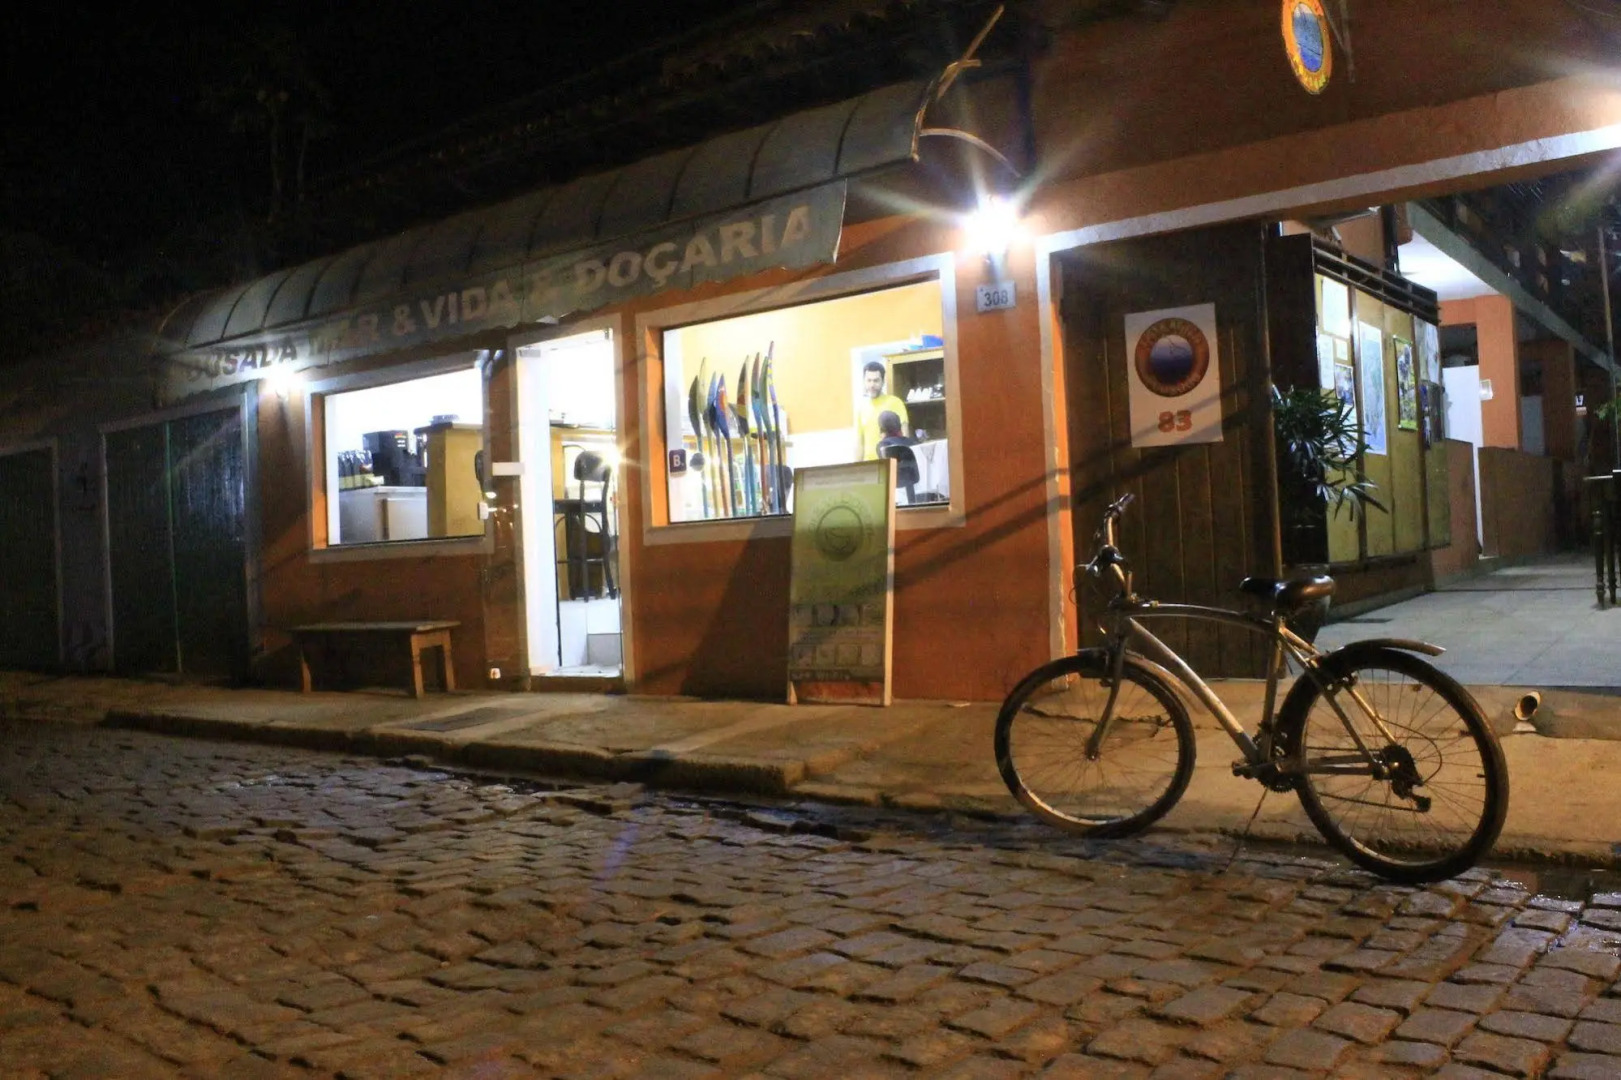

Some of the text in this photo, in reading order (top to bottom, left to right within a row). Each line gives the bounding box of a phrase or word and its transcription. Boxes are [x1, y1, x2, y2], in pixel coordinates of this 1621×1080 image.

[392, 304, 416, 337] &
[420, 278, 518, 330] VIDA
[571, 205, 812, 296] DOÇARIA
[983, 288, 1009, 308] 308
[1158, 409, 1193, 433] 83
